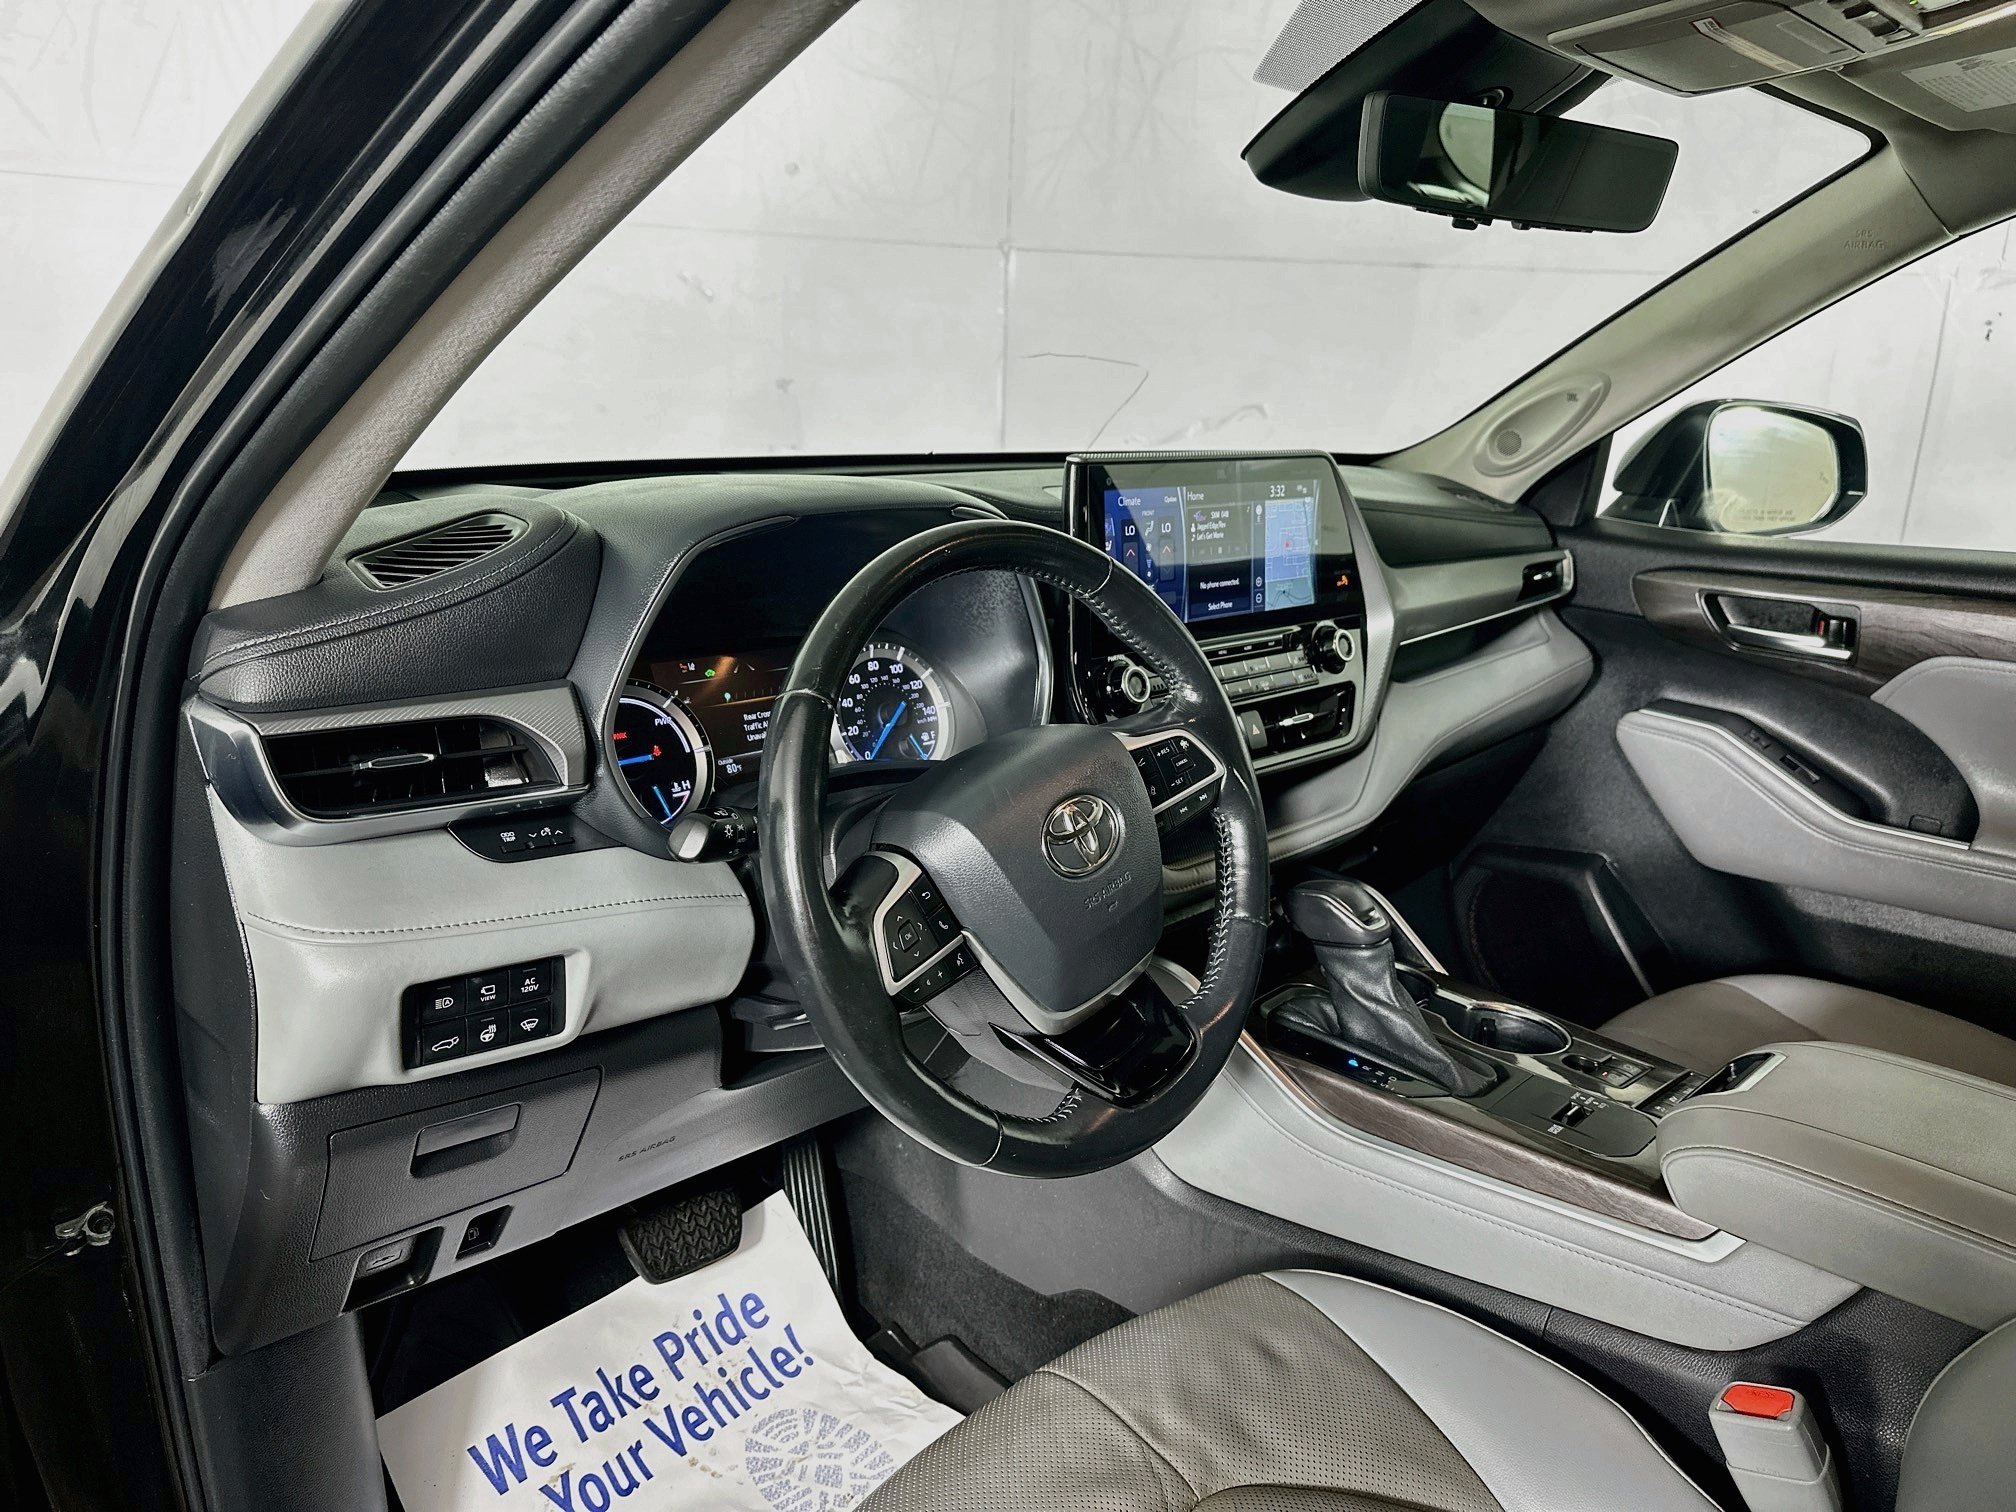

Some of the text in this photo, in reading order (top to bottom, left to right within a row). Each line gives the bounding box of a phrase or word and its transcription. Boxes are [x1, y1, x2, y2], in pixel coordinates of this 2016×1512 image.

[1855, 229, 1873, 239] SRS
[1842, 239, 1885, 250] AIRBAG
[1187, 491, 1204, 501] Home
[1269, 485, 1286, 498] 3:32
[1117, 496, 1141, 507] Climate
[1125, 525, 1136, 536] LO
[1161, 522, 1171, 533] LO
[1200, 581, 1206, 590] No
[1206, 581, 1219, 590] phone
[1208, 601, 1233, 611] Select Phone
[867, 660, 880, 671] 80
[889, 664, 904, 674] 100
[849, 673, 860, 685] 60
[910, 680, 923, 690] 120
[856, 693, 864, 701] 80
[841, 698, 854, 708] 40
[743, 710, 771, 721] Rear Cros
[922, 705, 936, 716] 140
[654, 716, 672, 726] PWR
[743, 723, 763, 732] Traffic
[847, 725, 859, 736] 20
[930, 730, 936, 740] F
[864, 751, 871, 760] 0
[681, 780, 691, 790] H
[1083, 871, 1131, 910] SRS AIRBAG
[904, 933, 913, 941] OK
[524, 977, 536, 986] AC
[521, 984, 539, 993] 120V
[480, 994, 496, 1002] VIEW
[618, 1136, 676, 1161] SRS AIRBAG
[467, 1292, 770, 1496] We Take Pride
[538, 1439, 654, 1512] Your
[642, 1323, 814, 1458] Vehicle!
